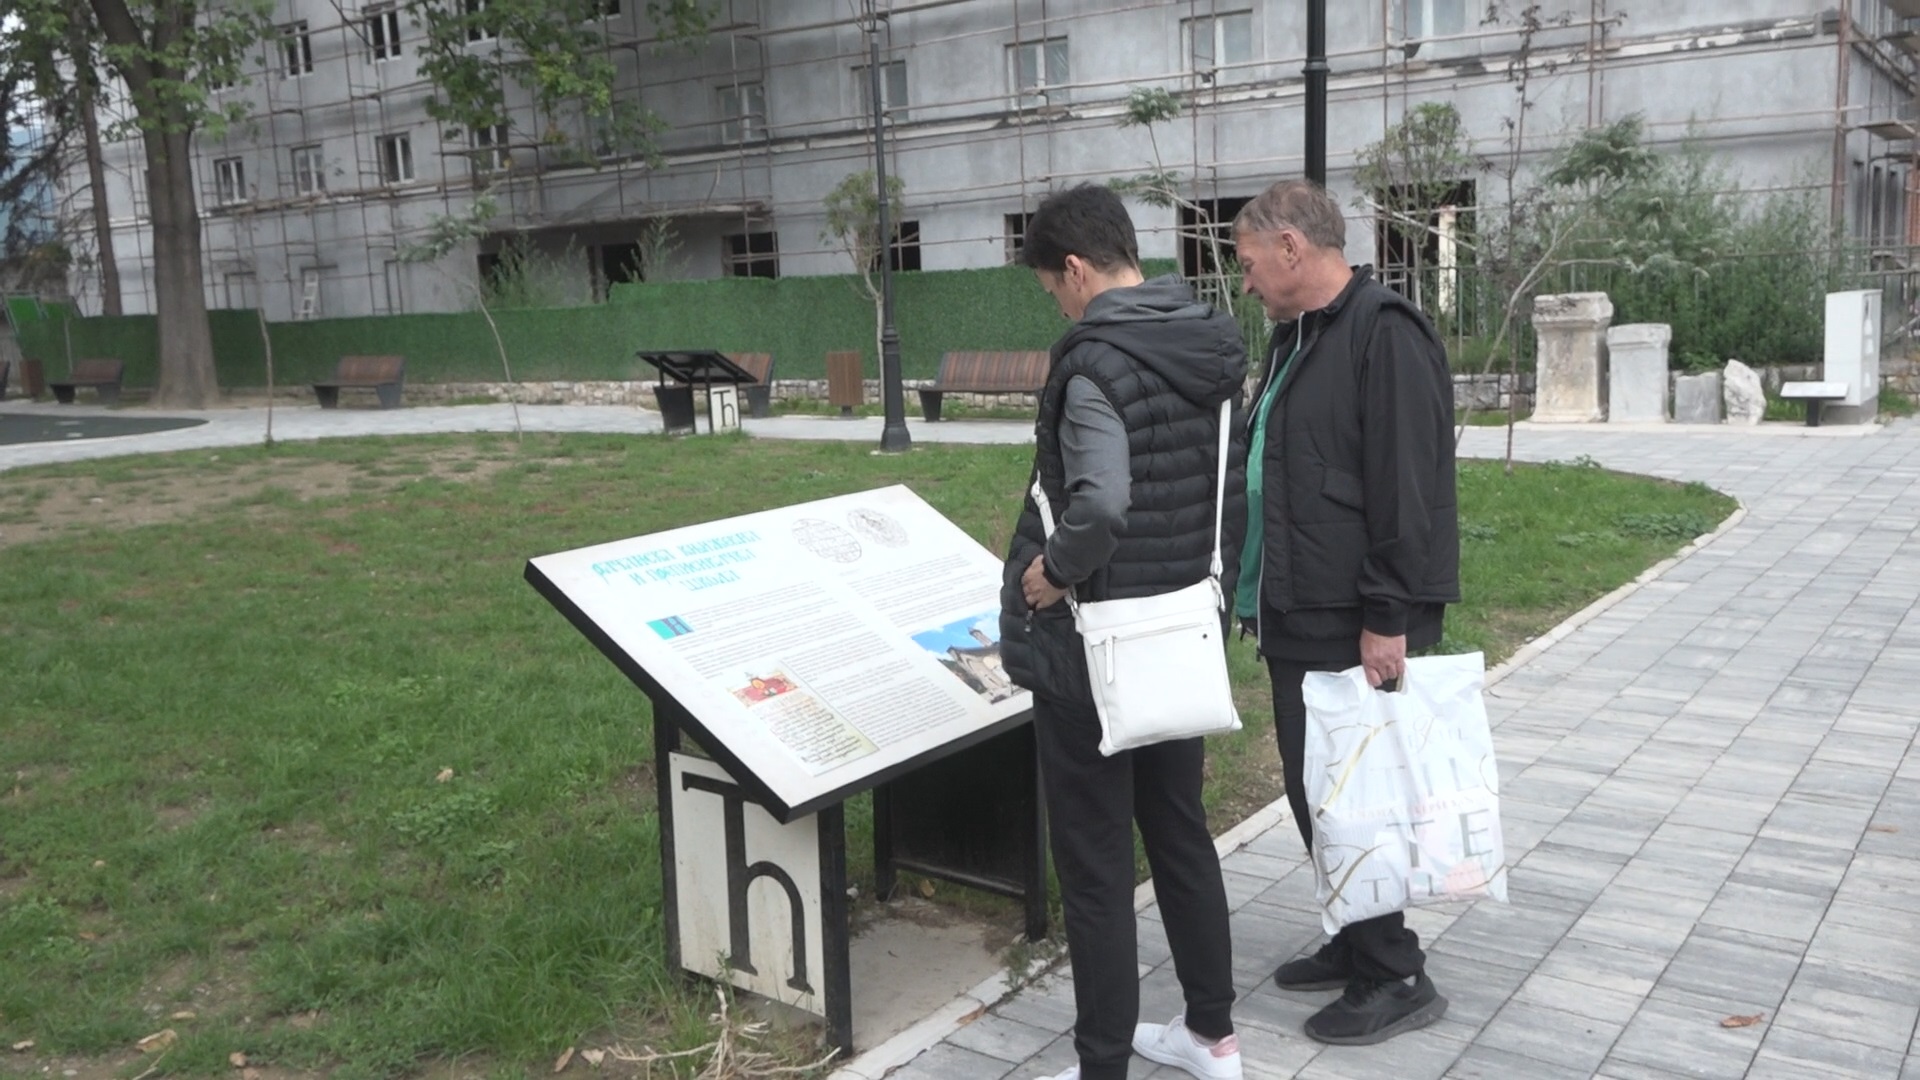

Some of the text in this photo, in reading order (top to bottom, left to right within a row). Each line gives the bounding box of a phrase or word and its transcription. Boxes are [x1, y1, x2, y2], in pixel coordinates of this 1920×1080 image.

[629, 548, 757, 587] И ПРЕПИСИВАЧКА
[679, 569, 741, 591] ШКОЛА
